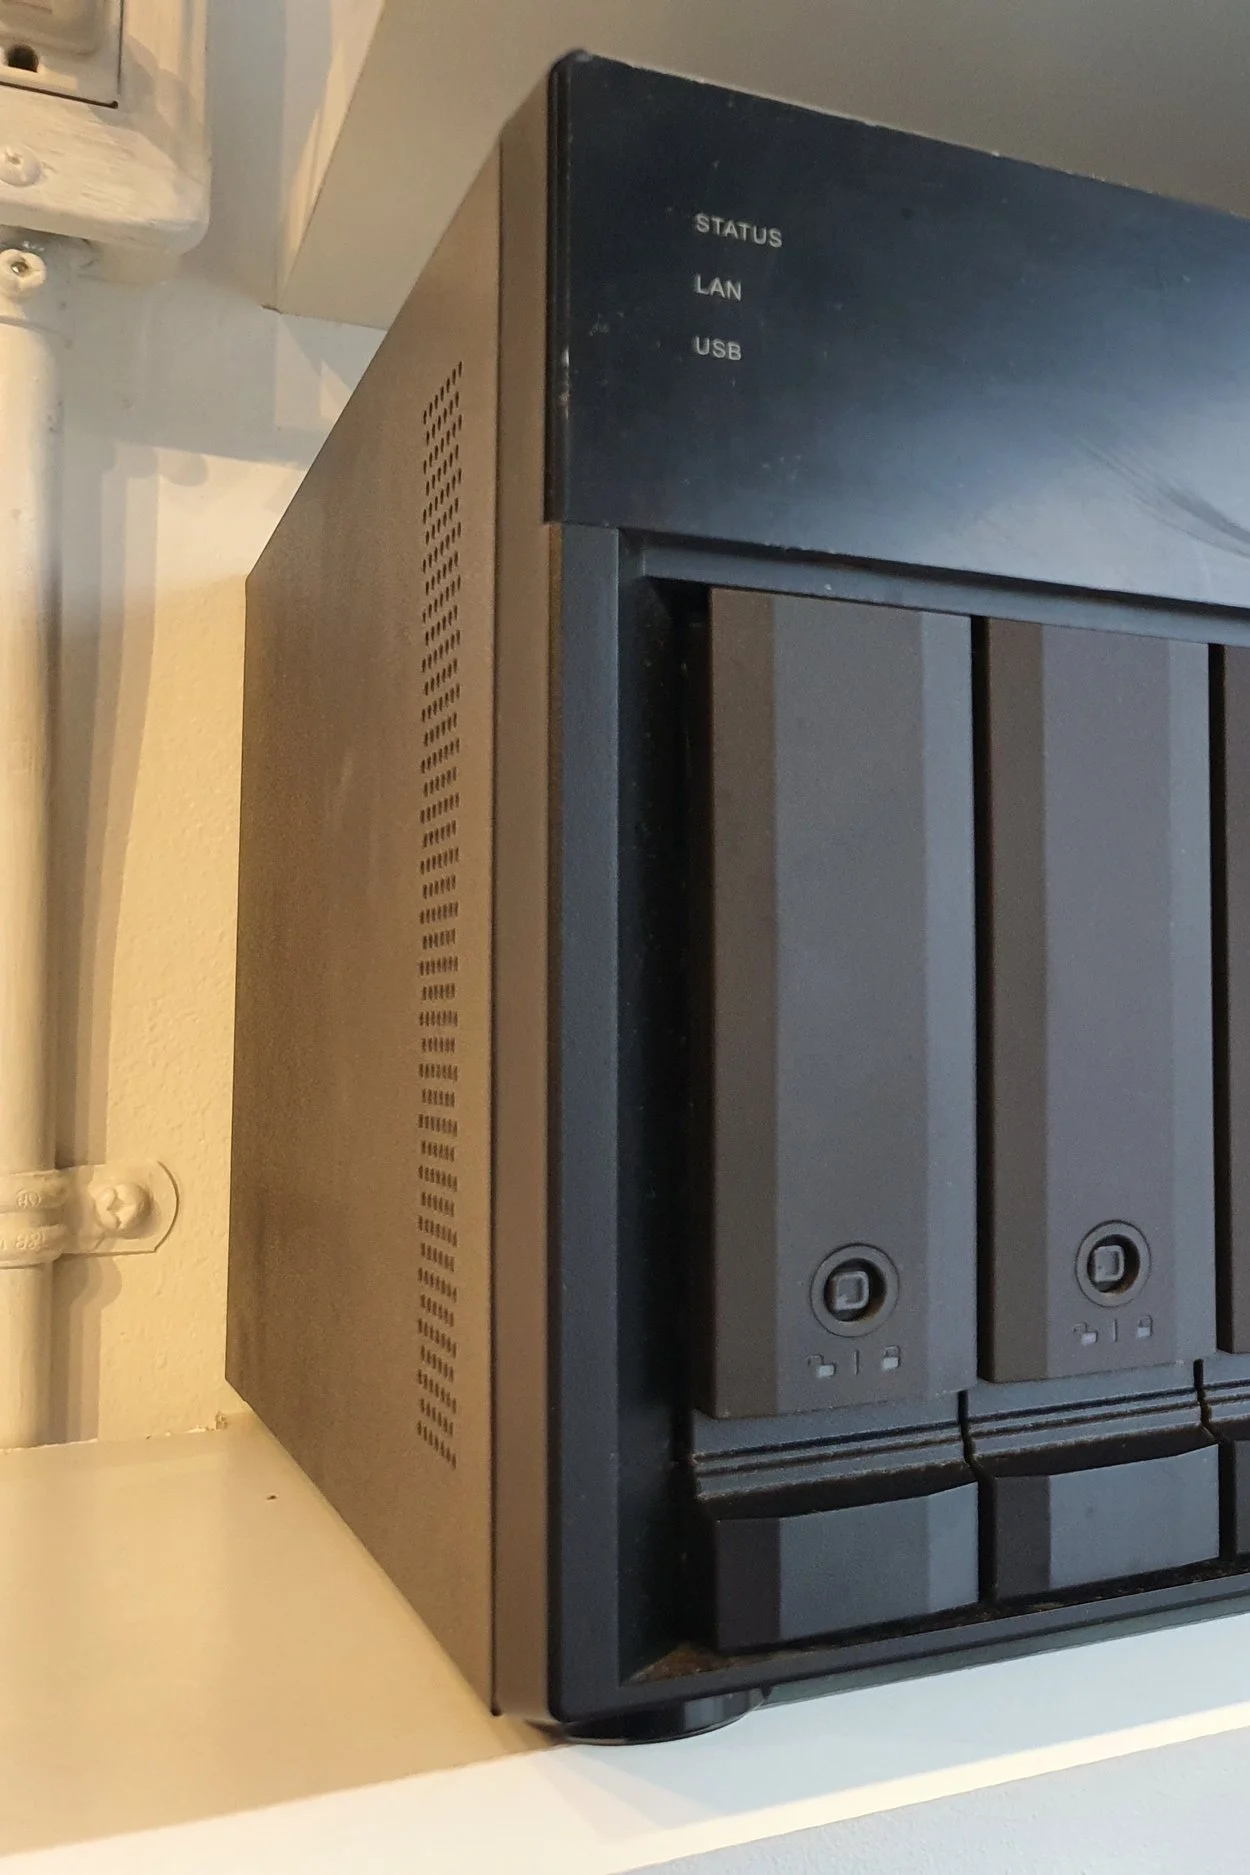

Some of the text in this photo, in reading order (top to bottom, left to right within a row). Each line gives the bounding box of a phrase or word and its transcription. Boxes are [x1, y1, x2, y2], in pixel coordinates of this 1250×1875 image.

[695, 213, 783, 248] STATUS
[695, 274, 742, 301] LAN
[695, 335, 742, 361] USB
